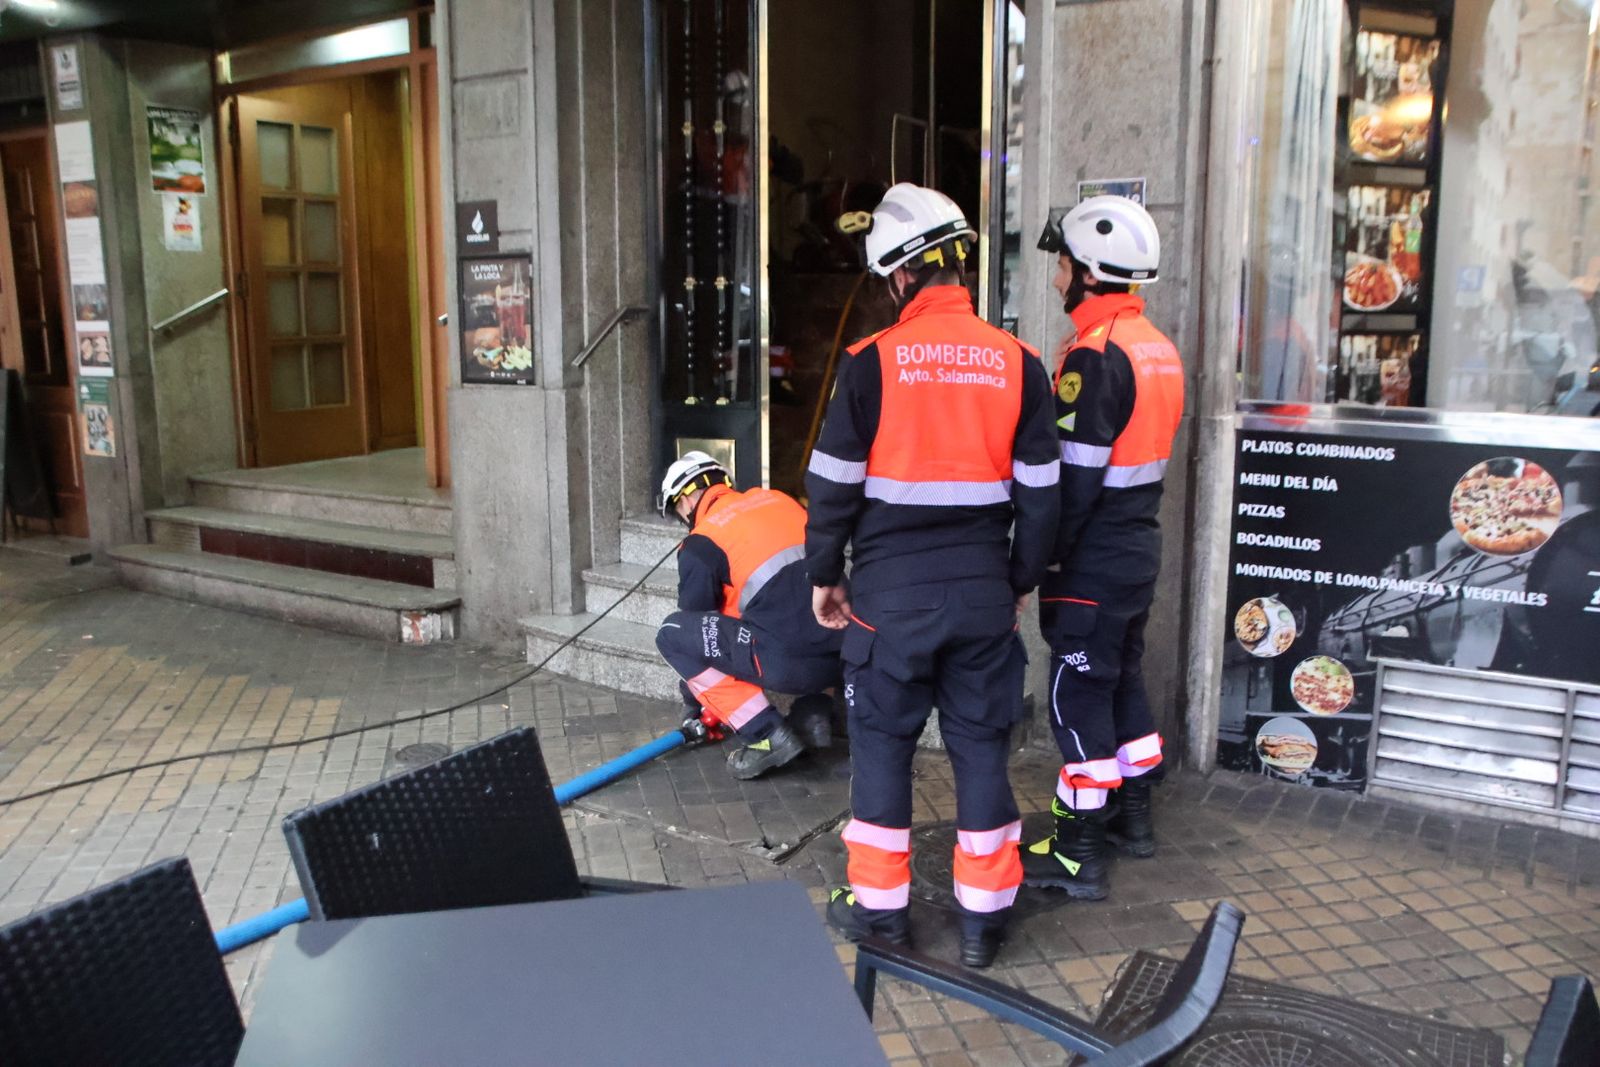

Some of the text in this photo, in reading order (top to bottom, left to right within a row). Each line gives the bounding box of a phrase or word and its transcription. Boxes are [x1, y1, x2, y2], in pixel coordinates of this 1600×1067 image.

[896, 343, 1005, 371] BOMBEROS
[898, 368, 1006, 388] Ayto. Salamanca
[1241, 439, 1395, 461] PLATOS COMBINADOS
[1240, 472, 1338, 492] MENU DEL DÍA
[1238, 503, 1285, 518] PIZZAS
[1236, 532, 1322, 551] BOCADILLOS
[1235, 563, 1312, 582] MONTADOS
[1314, 570, 1333, 584] DE
[1449, 585, 1460, 597] Y
[1462, 586, 1548, 607] VEGETALES
